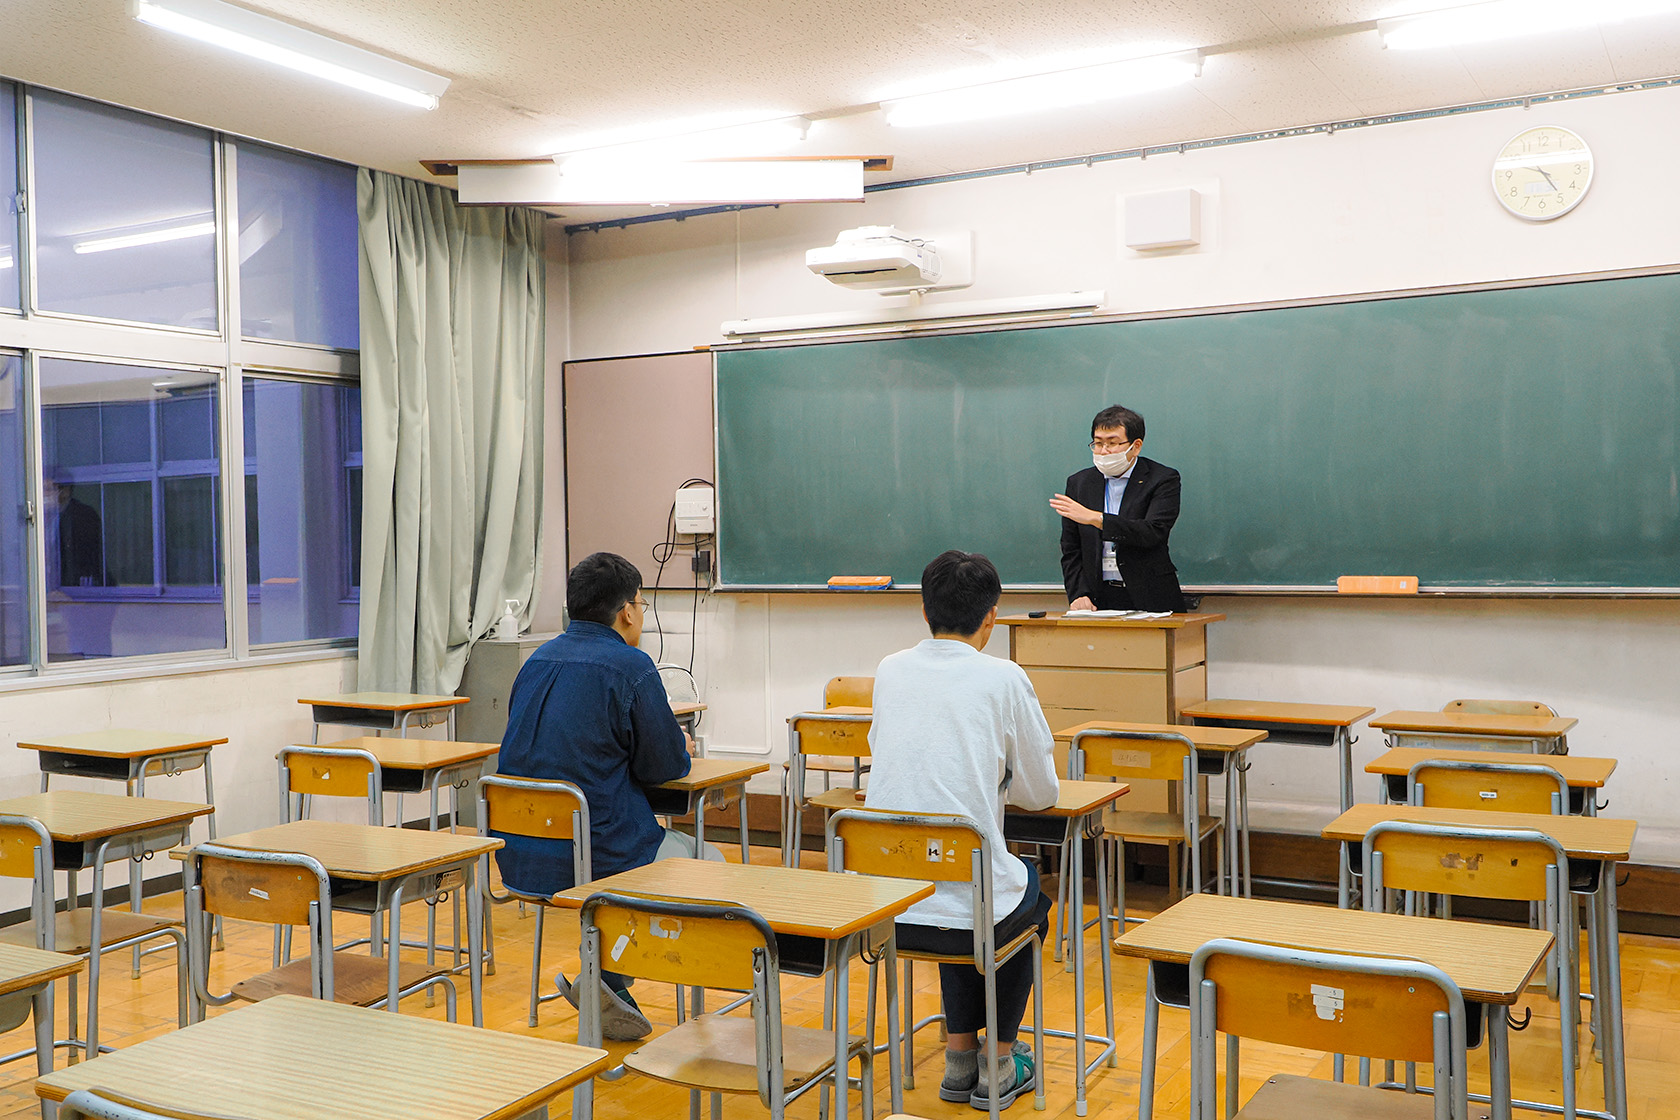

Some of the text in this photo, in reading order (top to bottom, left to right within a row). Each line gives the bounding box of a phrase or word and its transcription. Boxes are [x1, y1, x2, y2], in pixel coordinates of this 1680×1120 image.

[1520, 138, 1531, 152] 11
[1538, 136, 1550, 147] 12
[1574, 164, 1582, 175] 3
[1505, 170, 1513, 182] 9
[1569, 180, 1576, 190] 4
[1510, 186, 1518, 197] 8
[1523, 196, 1531, 207] 7
[1538, 198, 1546, 209] 6
[1557, 192, 1564, 204] 5
